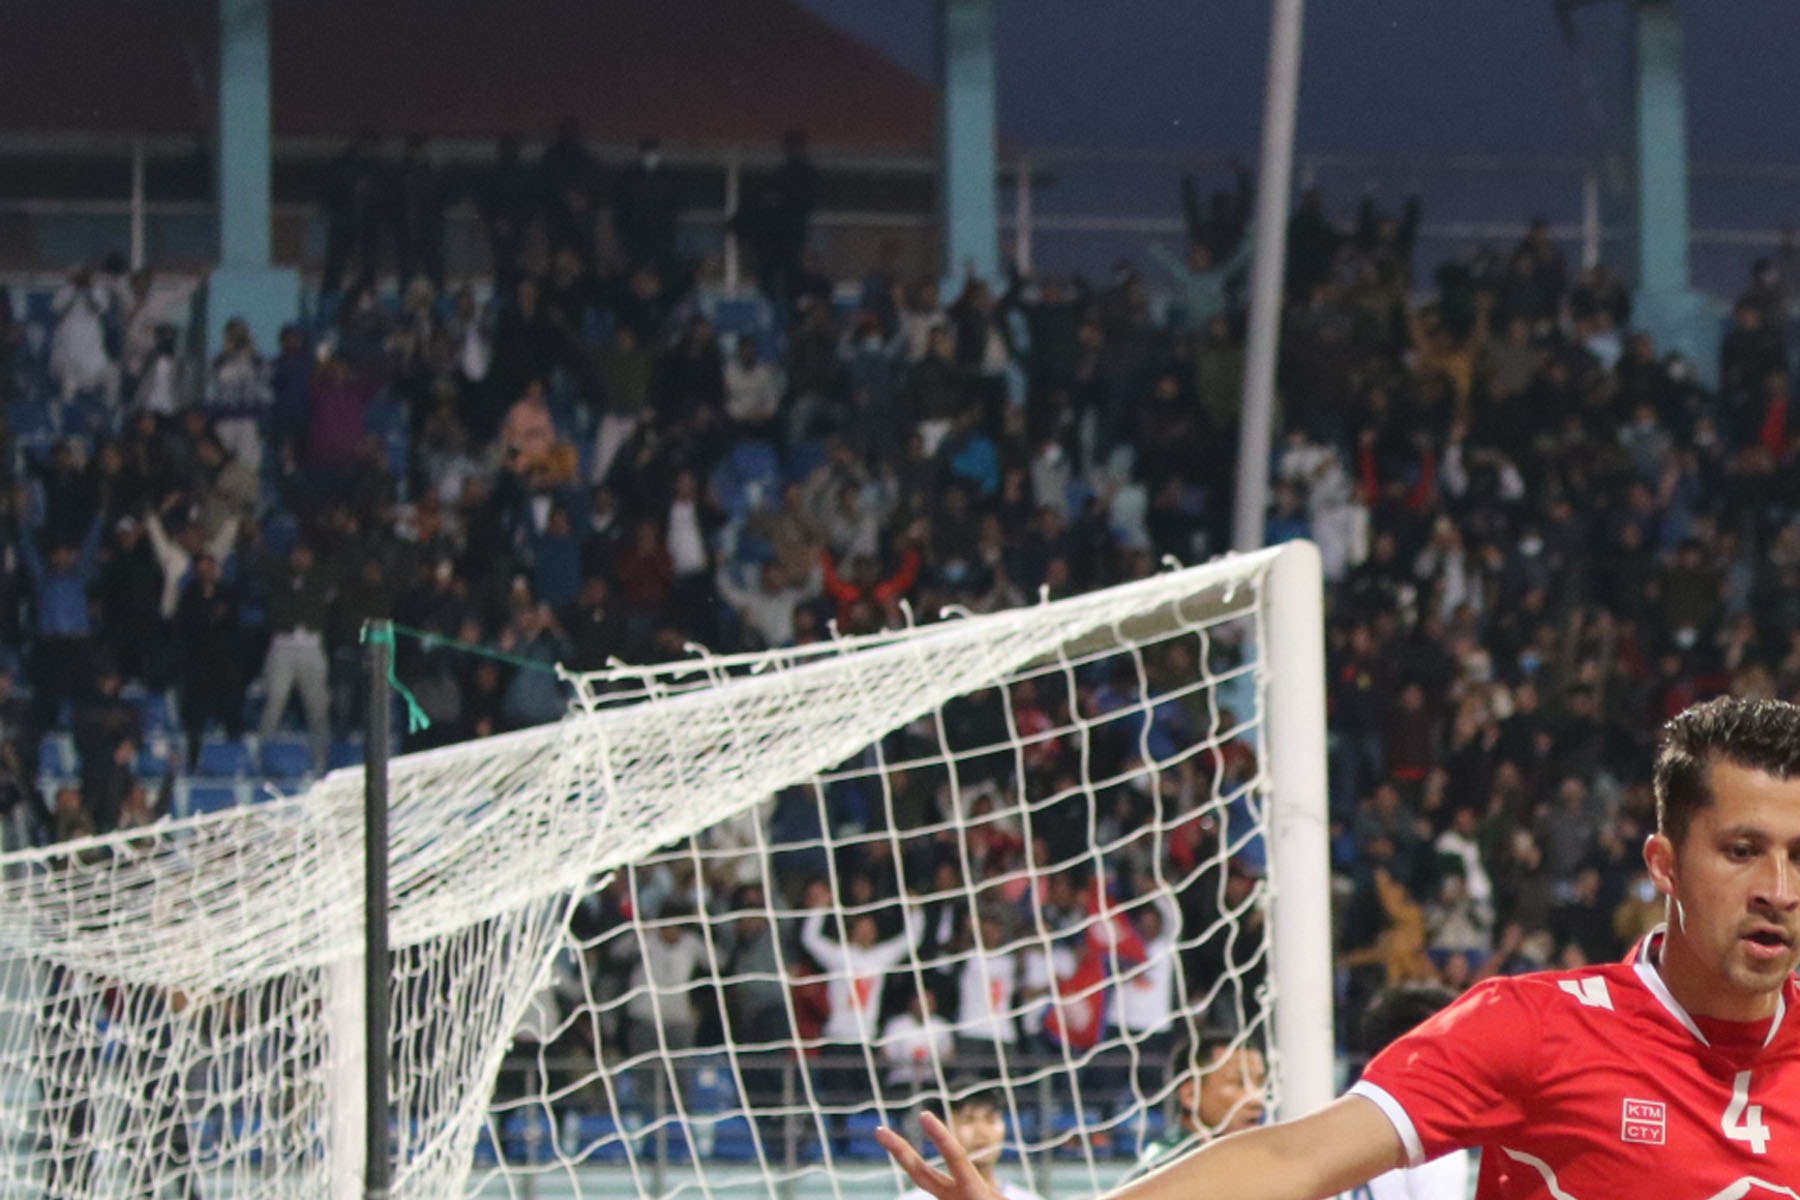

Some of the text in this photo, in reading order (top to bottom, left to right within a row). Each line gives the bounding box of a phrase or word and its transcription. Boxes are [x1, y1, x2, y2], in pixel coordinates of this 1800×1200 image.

[1628, 1104, 1662, 1118] KTM
[1720, 1070, 1771, 1154] 4
[1627, 1126, 1660, 1139] CTY
